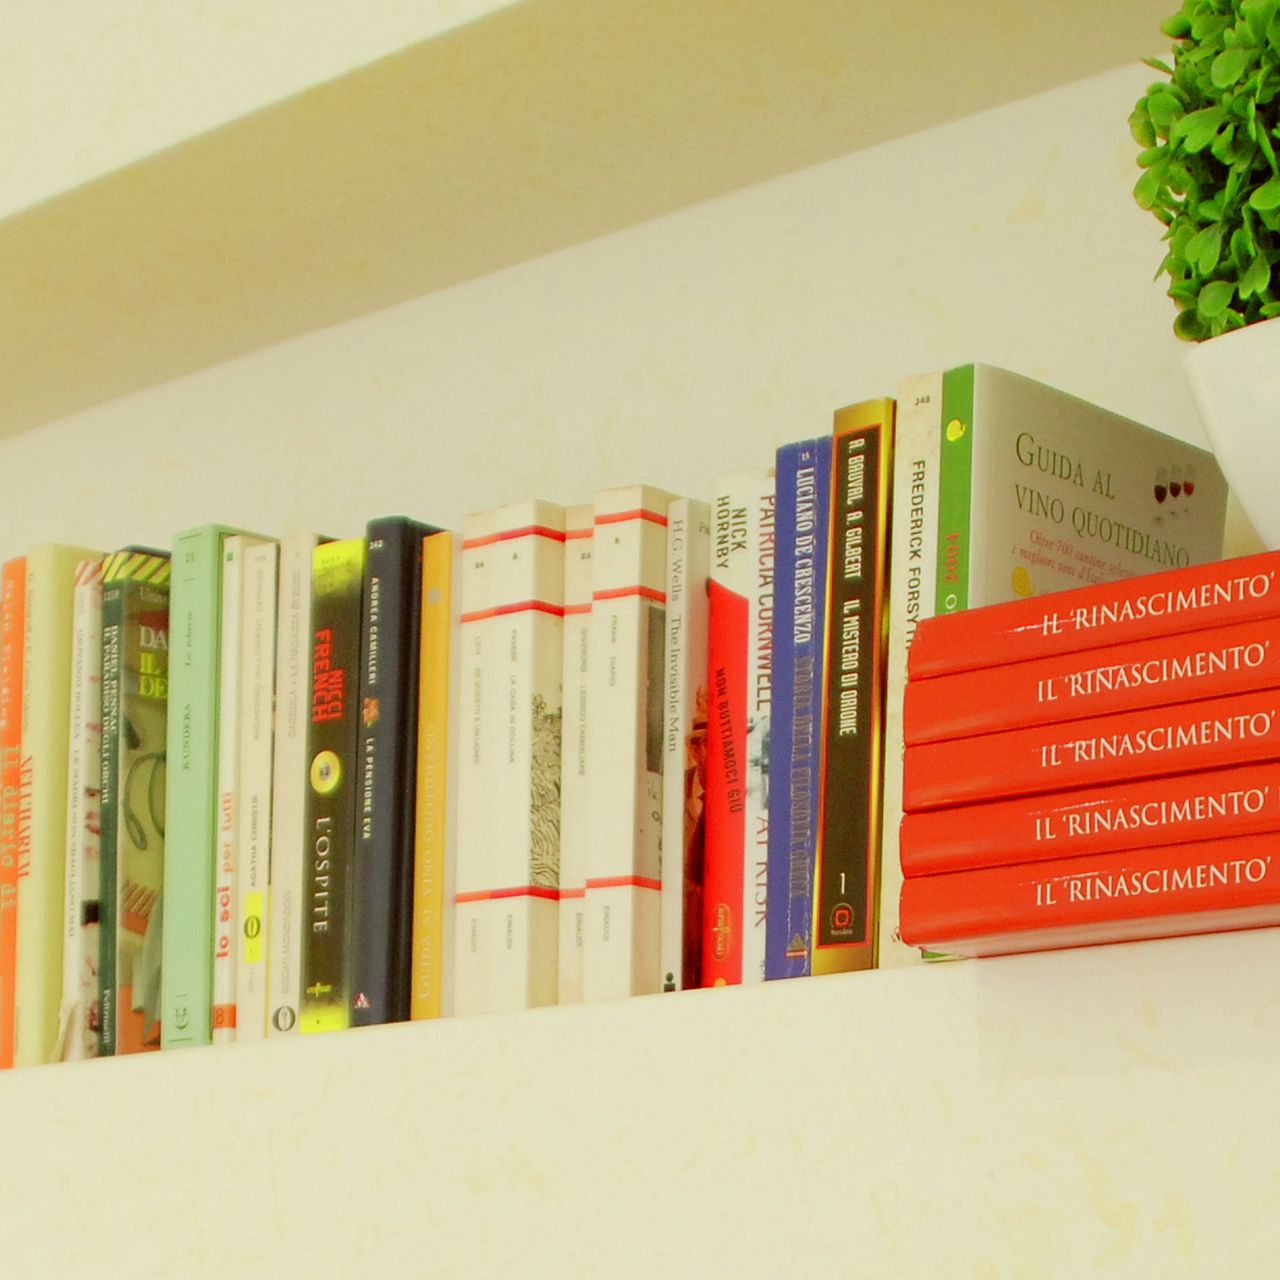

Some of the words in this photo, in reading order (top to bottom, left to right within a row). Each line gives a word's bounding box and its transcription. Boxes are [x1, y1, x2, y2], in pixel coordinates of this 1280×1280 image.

[795, 467, 814, 531] LUCIANO
[847, 456, 864, 505] BAUVAL
[1093, 470, 1116, 499] AL
[715, 494, 732, 569] HORNBY
[730, 509, 747, 552] NICK
[908, 459, 926, 562] FREDERICK
[1015, 484, 1065, 524] VINO
[1072, 507, 1190, 568] QUOTIDIANO
[794, 534, 811, 556] DE
[843, 528, 862, 579] GILBERT
[369, 577, 380, 620] ANDREA
[670, 558, 684, 602] Wells
[792, 559, 812, 644] CRESCENZO
[669, 614, 682, 641] The
[842, 600, 860, 613] IL
[1042, 613, 1063, 636] IL
[367, 624, 379, 686] CAMILLERI
[840, 615, 859, 670] MISTERO
[313, 628, 333, 723] FRENCH
[327, 668, 345, 719] NICCI
[667, 643, 681, 715] Invisible
[713, 667, 726, 696] NON
[841, 673, 858, 687] DI
[1037, 678, 1059, 703] IL
[838, 689, 857, 735] ORIONE
[366, 737, 376, 751] LA
[666, 719, 678, 752] Man
[716, 702, 738, 786] BUTTIAMOCI
[1040, 744, 1062, 768] IL
[363, 754, 375, 811] PENSIONE
[361, 815, 372, 839] EVA
[1034, 816, 1057, 841] IL
[313, 816, 333, 934] L'OSPITE
[1034, 882, 1057, 907] IL
